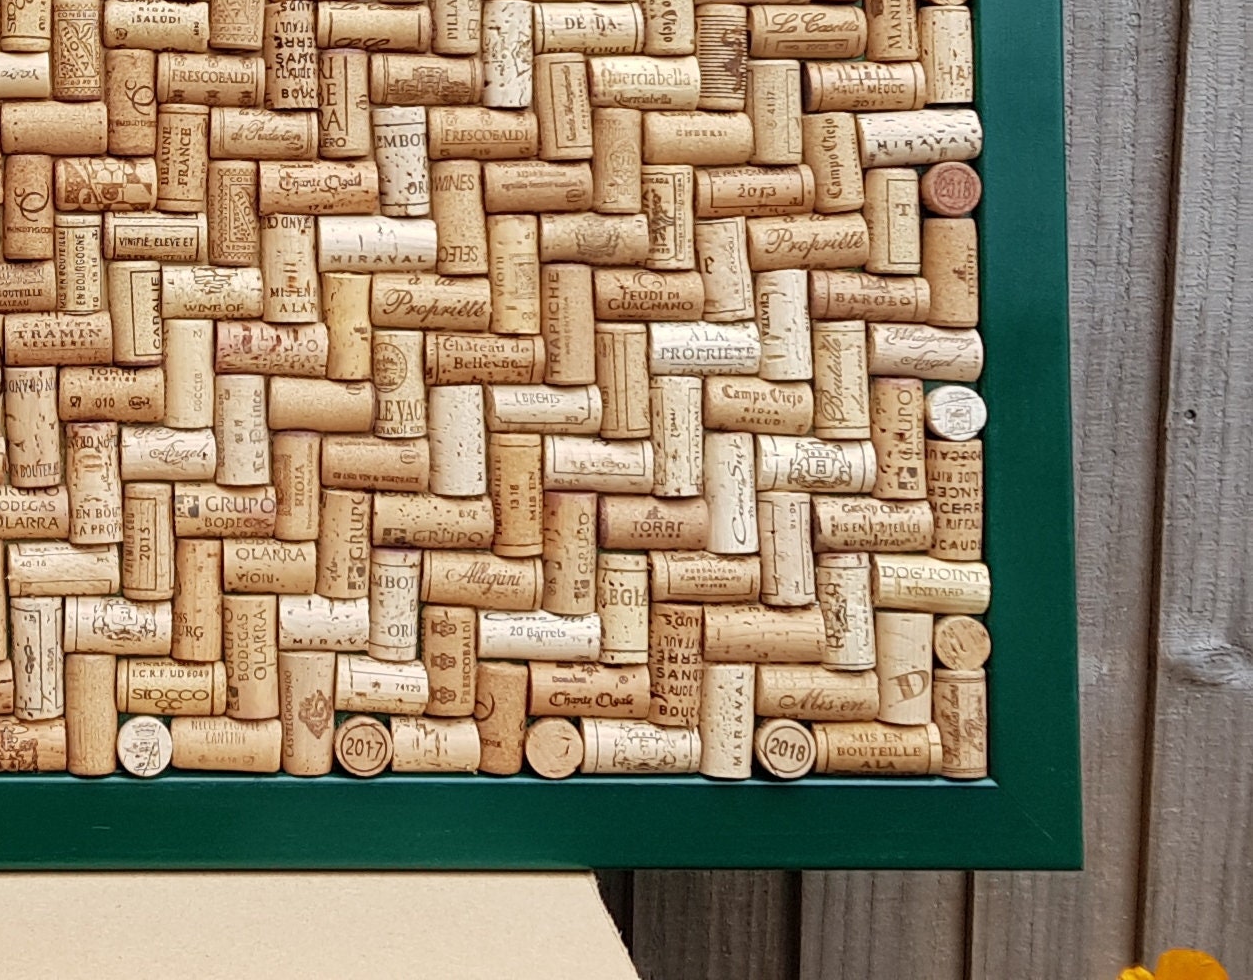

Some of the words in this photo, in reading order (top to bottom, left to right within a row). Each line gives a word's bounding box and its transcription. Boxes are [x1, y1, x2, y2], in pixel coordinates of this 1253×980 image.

[172, 69, 255, 84] FRESCOBALDI
[601, 68, 691, 89] Querciabella
[832, 82, 906, 95] HAUT-MEDOC
[824, 117, 838, 152] Viejo
[161, 126, 172, 186] BEAUNE
[178, 126, 192, 188] FRANCE
[434, 175, 475, 192] WINES
[826, 155, 842, 199] Campo
[331, 254, 426, 264] MIRAVAL
[608, 299, 694, 312] GUAGNANO
[548, 272, 561, 381] TRAPICHE
[721, 384, 767, 402] Campo
[769, 386, 804, 406] Viejo
[294, 465, 306, 507] RIOJA
[205, 496, 276, 515] GRUPO
[412, 529, 485, 544] GRUPO
[235, 547, 307, 563] OLARRA
[881, 566, 919, 581] DOG
[922, 566, 985, 583] POINT
[238, 612, 249, 682] BODEGAS
[461, 620, 472, 704] FRESCOBALDI
[733, 671, 745, 770] MIRAVAL
[345, 737, 385, 757] 2017
[851, 732, 879, 743] MIS
[882, 732, 904, 742] EN
[769, 738, 806, 762] 2018
[837, 746, 922, 758] BOUTEILLE
